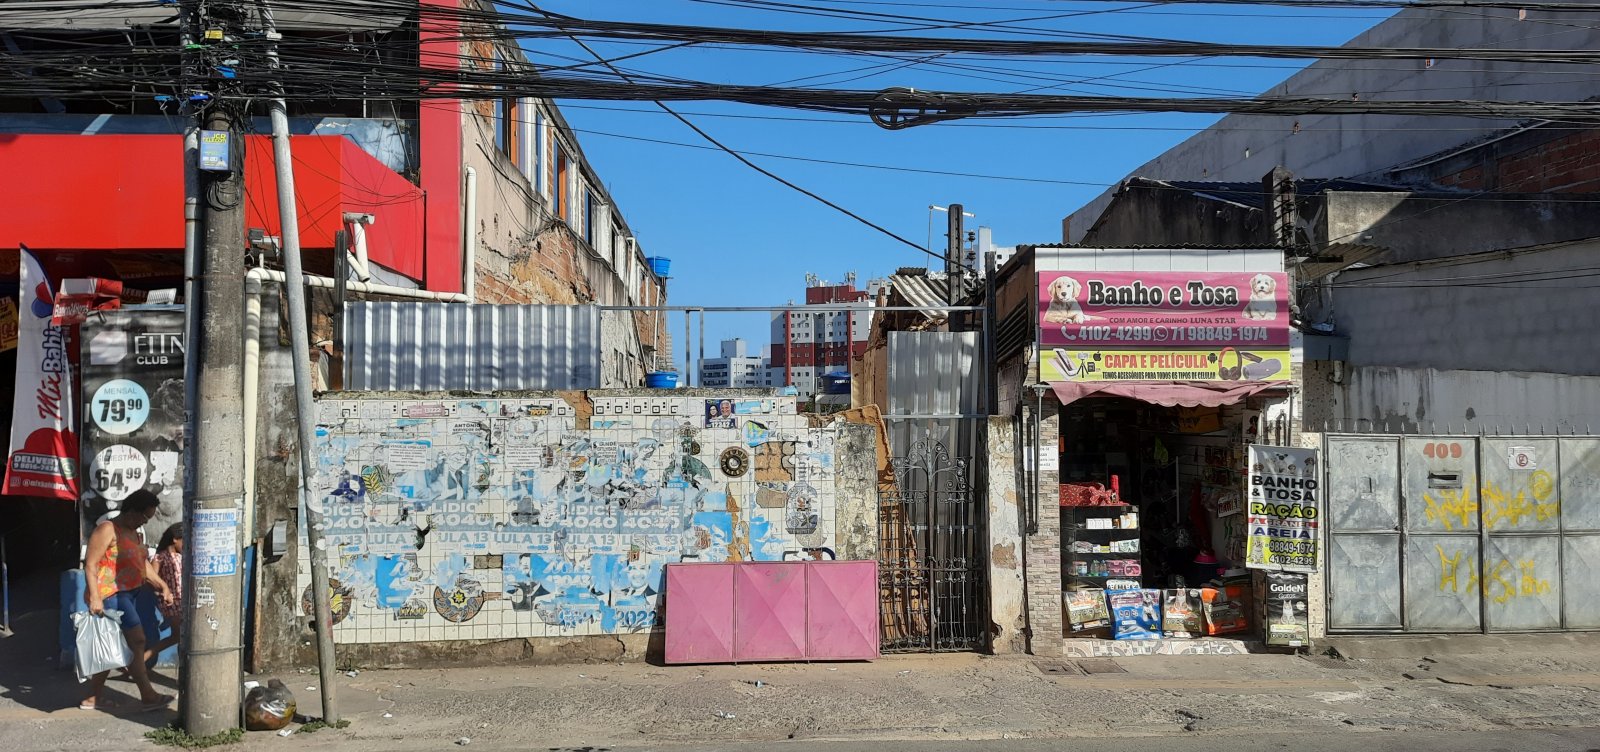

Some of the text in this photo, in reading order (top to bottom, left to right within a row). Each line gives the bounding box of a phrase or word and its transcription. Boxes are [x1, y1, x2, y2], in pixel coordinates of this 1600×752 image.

[1088, 281, 1238, 306] Banho e Tosa
[1078, 326, 1268, 341] 4102-4299 71 98849-1974
[134, 332, 185, 355] FITN
[136, 356, 169, 365] CLUB
[1104, 352, 1208, 369] CAPA E PELÍCULA
[1422, 442, 1463, 459] 409
[14, 455, 59, 467] DELIVERY
[1251, 475, 1318, 490] BANHO
[1251, 488, 1315, 502] & TOSA
[1250, 501, 1318, 519] RAÇÃO
[368, 535, 407, 545] LULA
[440, 532, 489, 543] ULA 13
[537, 534, 552, 545] 13
[568, 534, 616, 545] ULA 13
[1253, 527, 1311, 539] AREIA
[1269, 540, 1315, 555] 98849-1974
[1269, 554, 1315, 565] 4102-4299
